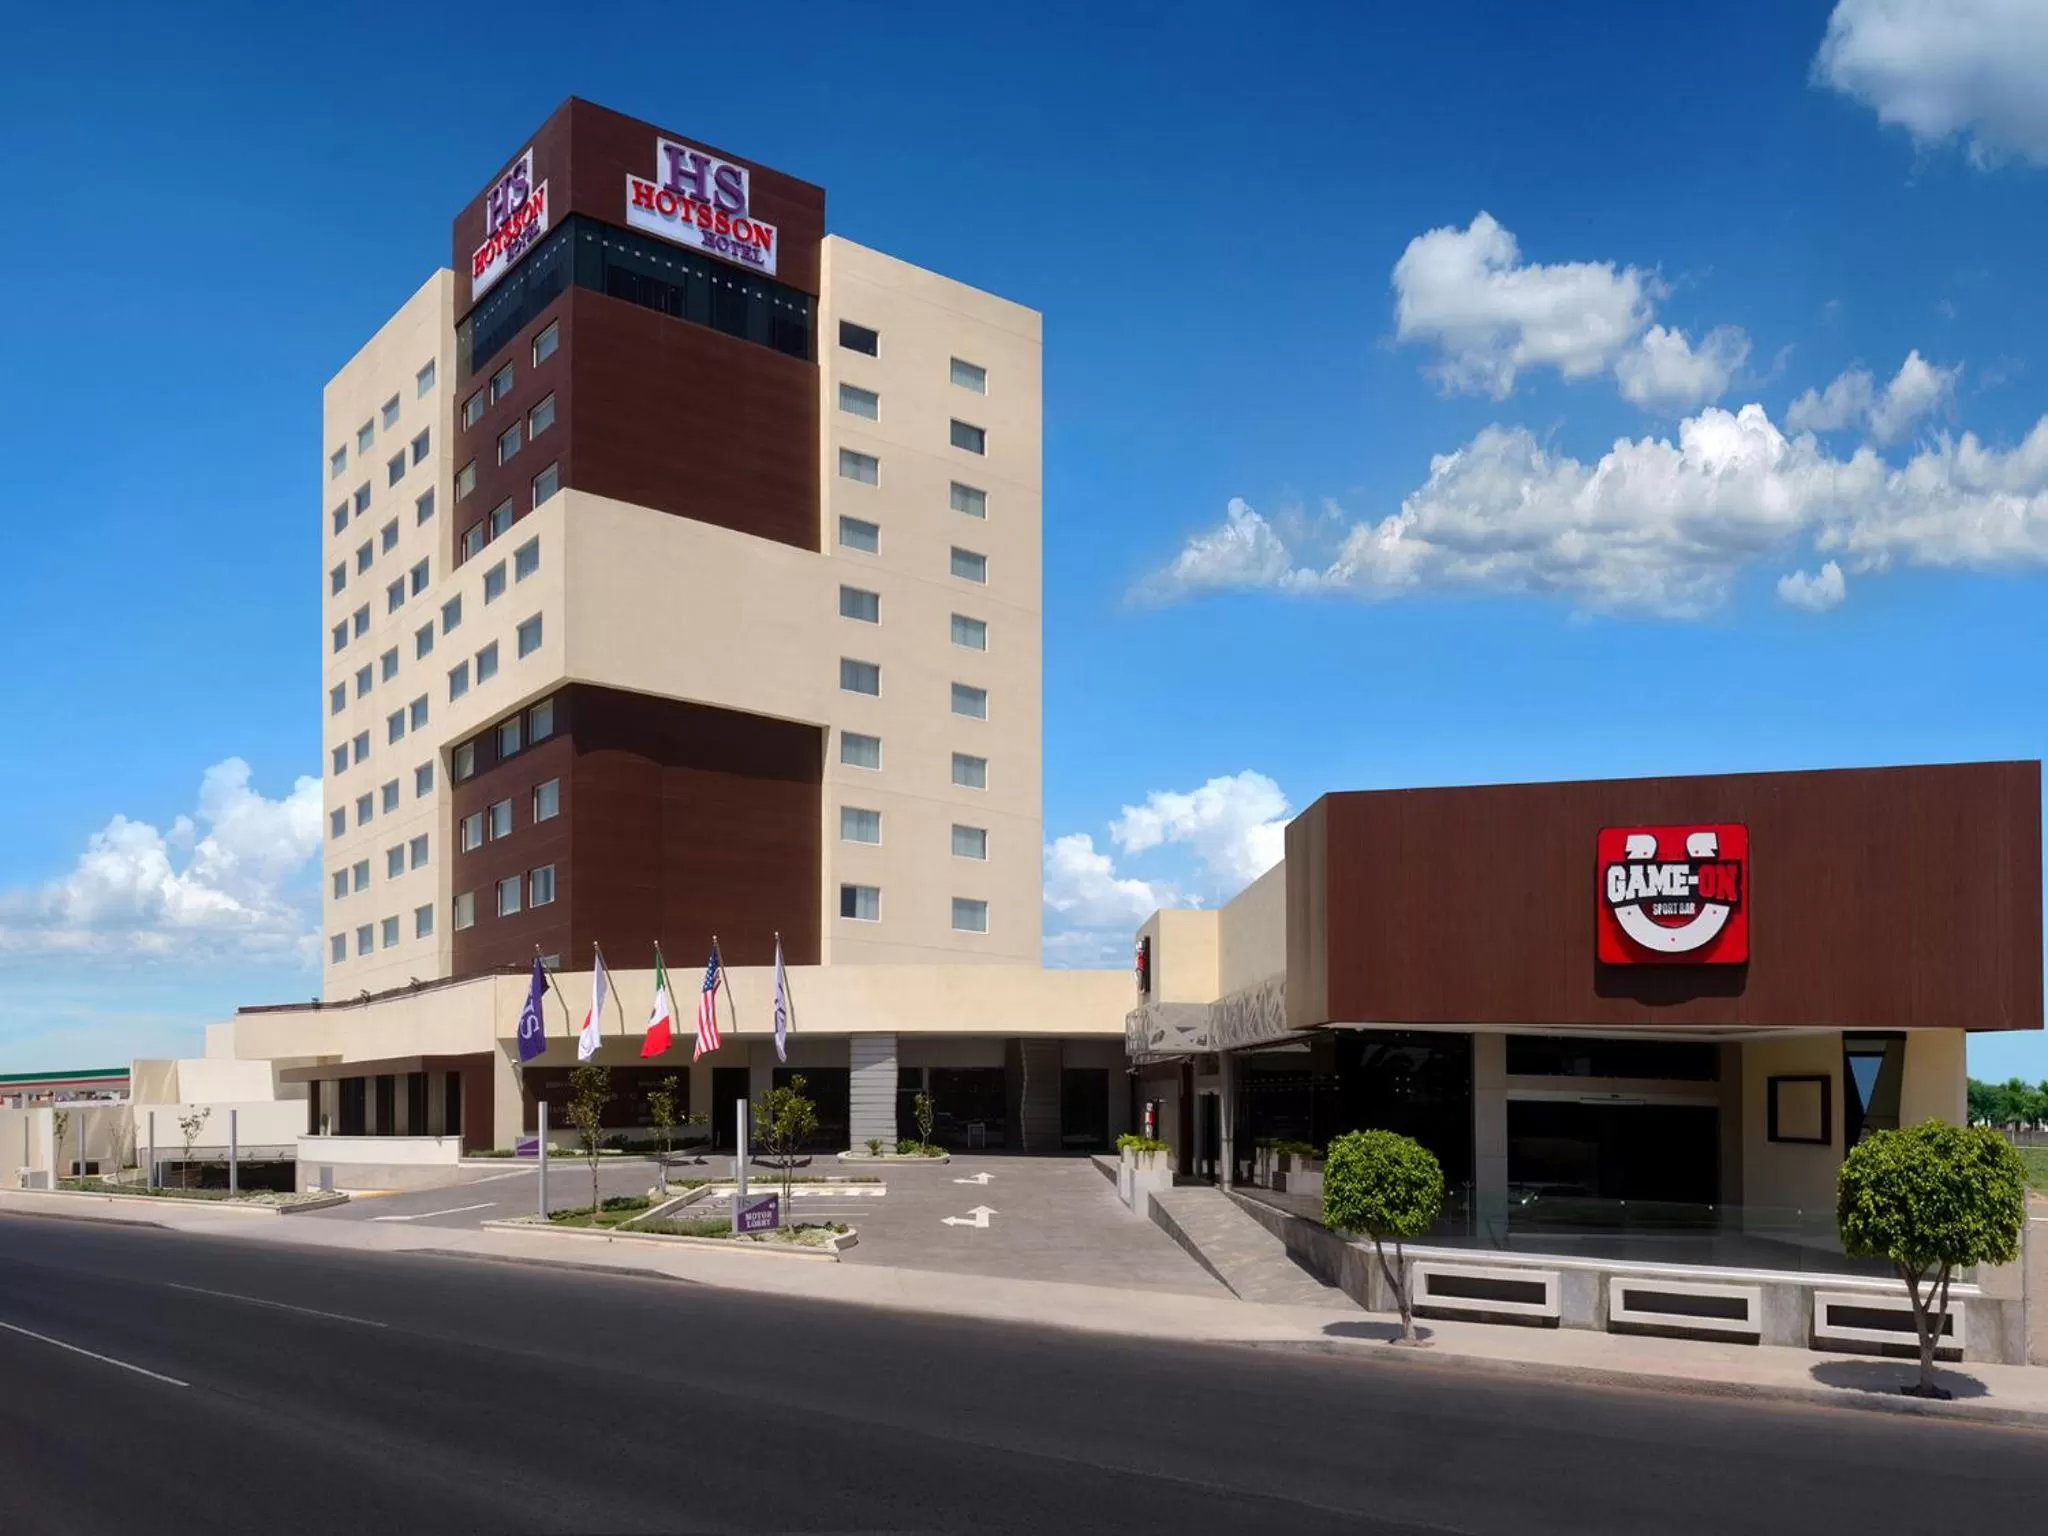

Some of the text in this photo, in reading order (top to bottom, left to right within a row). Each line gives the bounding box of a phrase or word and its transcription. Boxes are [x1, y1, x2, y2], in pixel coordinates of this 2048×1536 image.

[488, 158, 529, 239] HS
[663, 143, 746, 216] HS
[473, 187, 545, 278] HOTSSON
[631, 178, 774, 251] HOTSSON
[700, 229, 766, 266] HOTEL
[1607, 863, 1738, 904] GAME-ON
[1652, 902, 1696, 916] SPORT BAR
[745, 1211, 773, 1221] MOTOR
